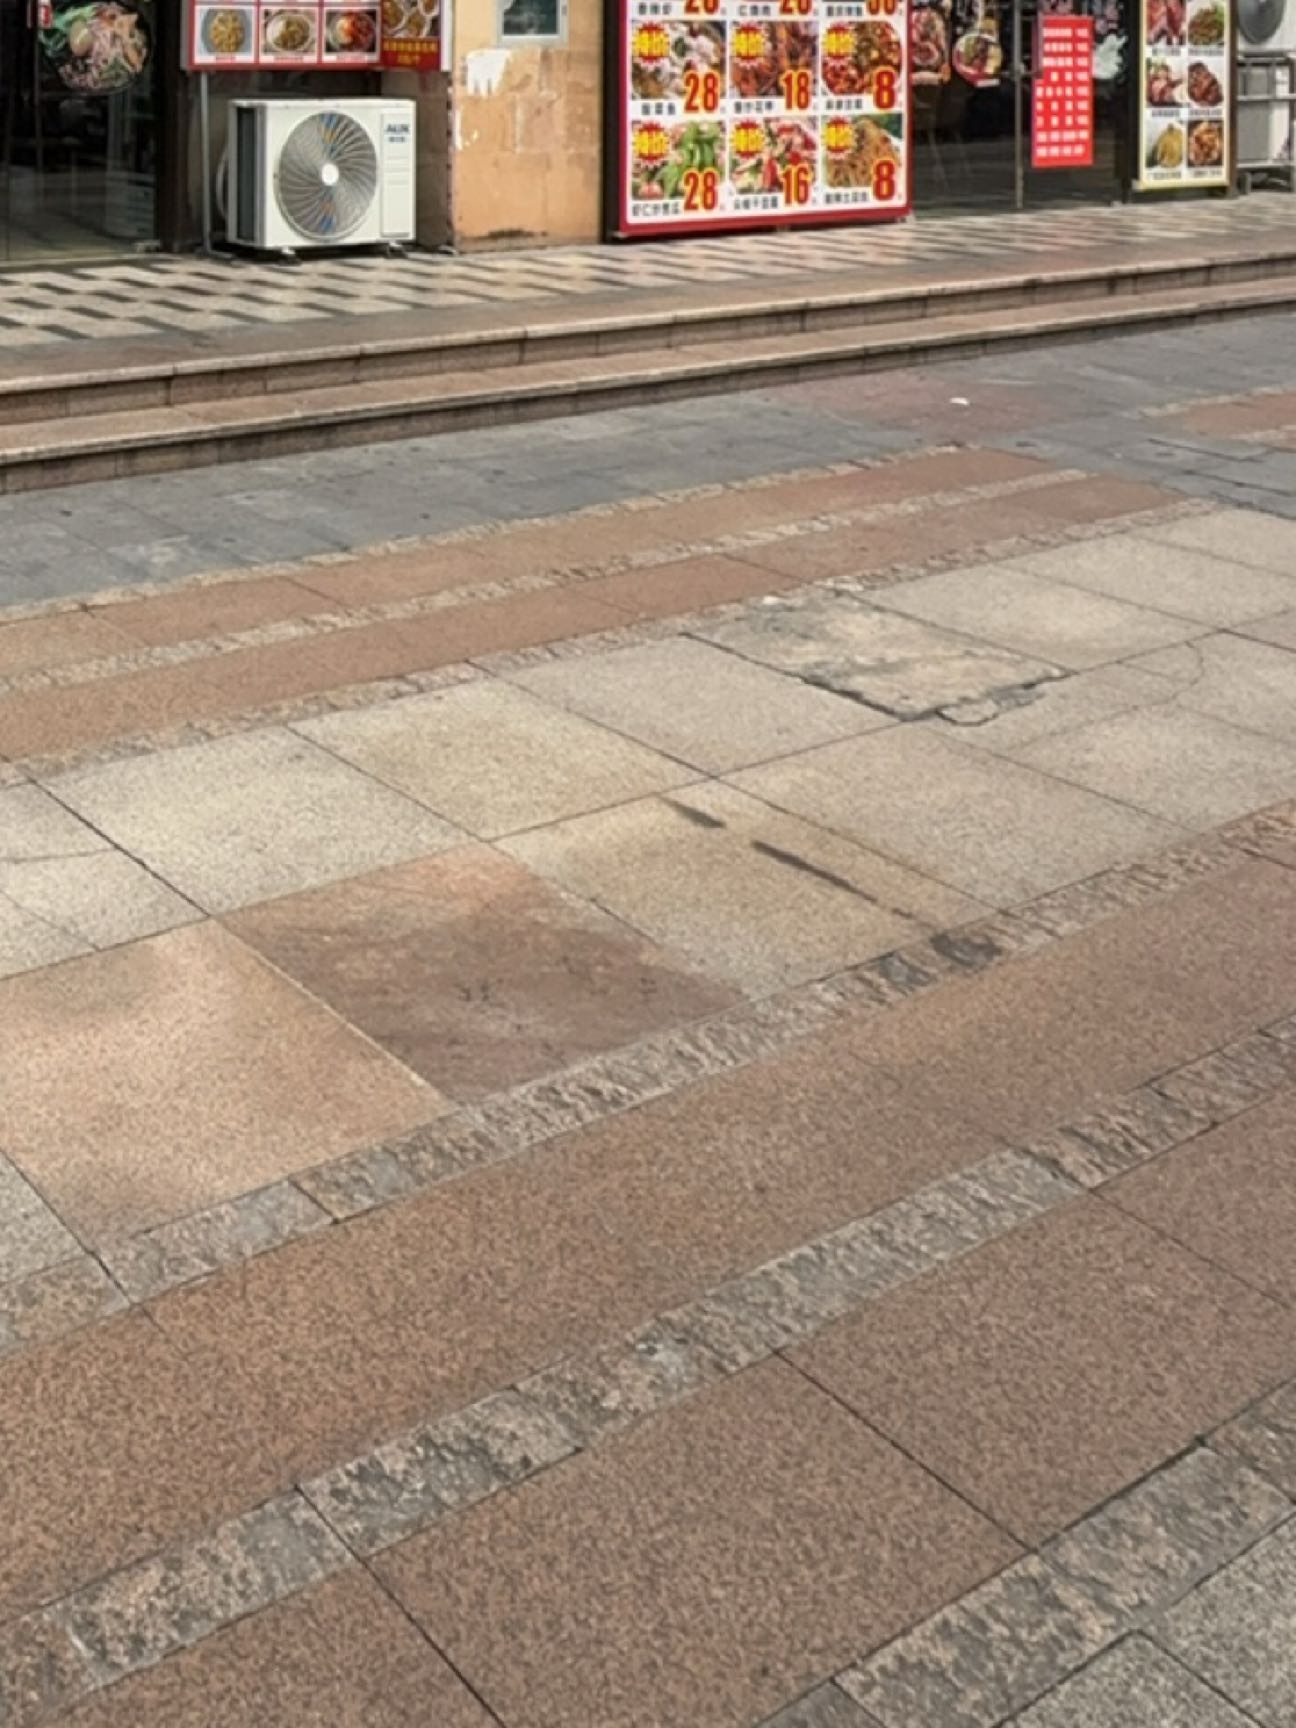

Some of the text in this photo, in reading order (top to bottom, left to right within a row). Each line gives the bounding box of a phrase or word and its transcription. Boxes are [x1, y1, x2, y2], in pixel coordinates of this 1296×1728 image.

[683, 71, 720, 113] 28
[782, 70, 810, 111] 18
[872, 69, 898, 111] 8
[683, 169, 719, 211] 28
[782, 165, 810, 205] 16
[872, 159, 897, 201] 8
